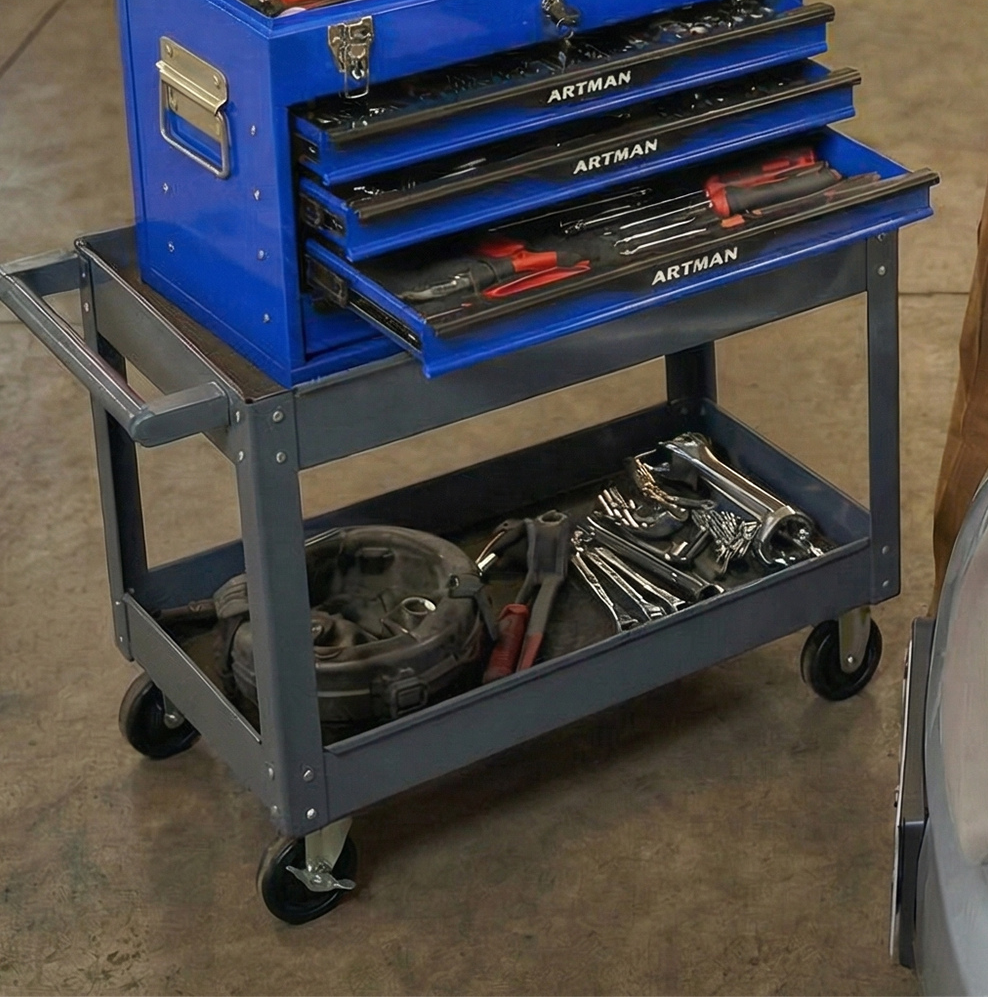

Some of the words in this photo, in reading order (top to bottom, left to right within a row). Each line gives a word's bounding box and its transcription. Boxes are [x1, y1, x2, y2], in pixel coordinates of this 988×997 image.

[547, 70, 632, 103] ARTMAN
[573, 139, 658, 174] ARTMAN
[651, 247, 738, 286] ARTMAN
